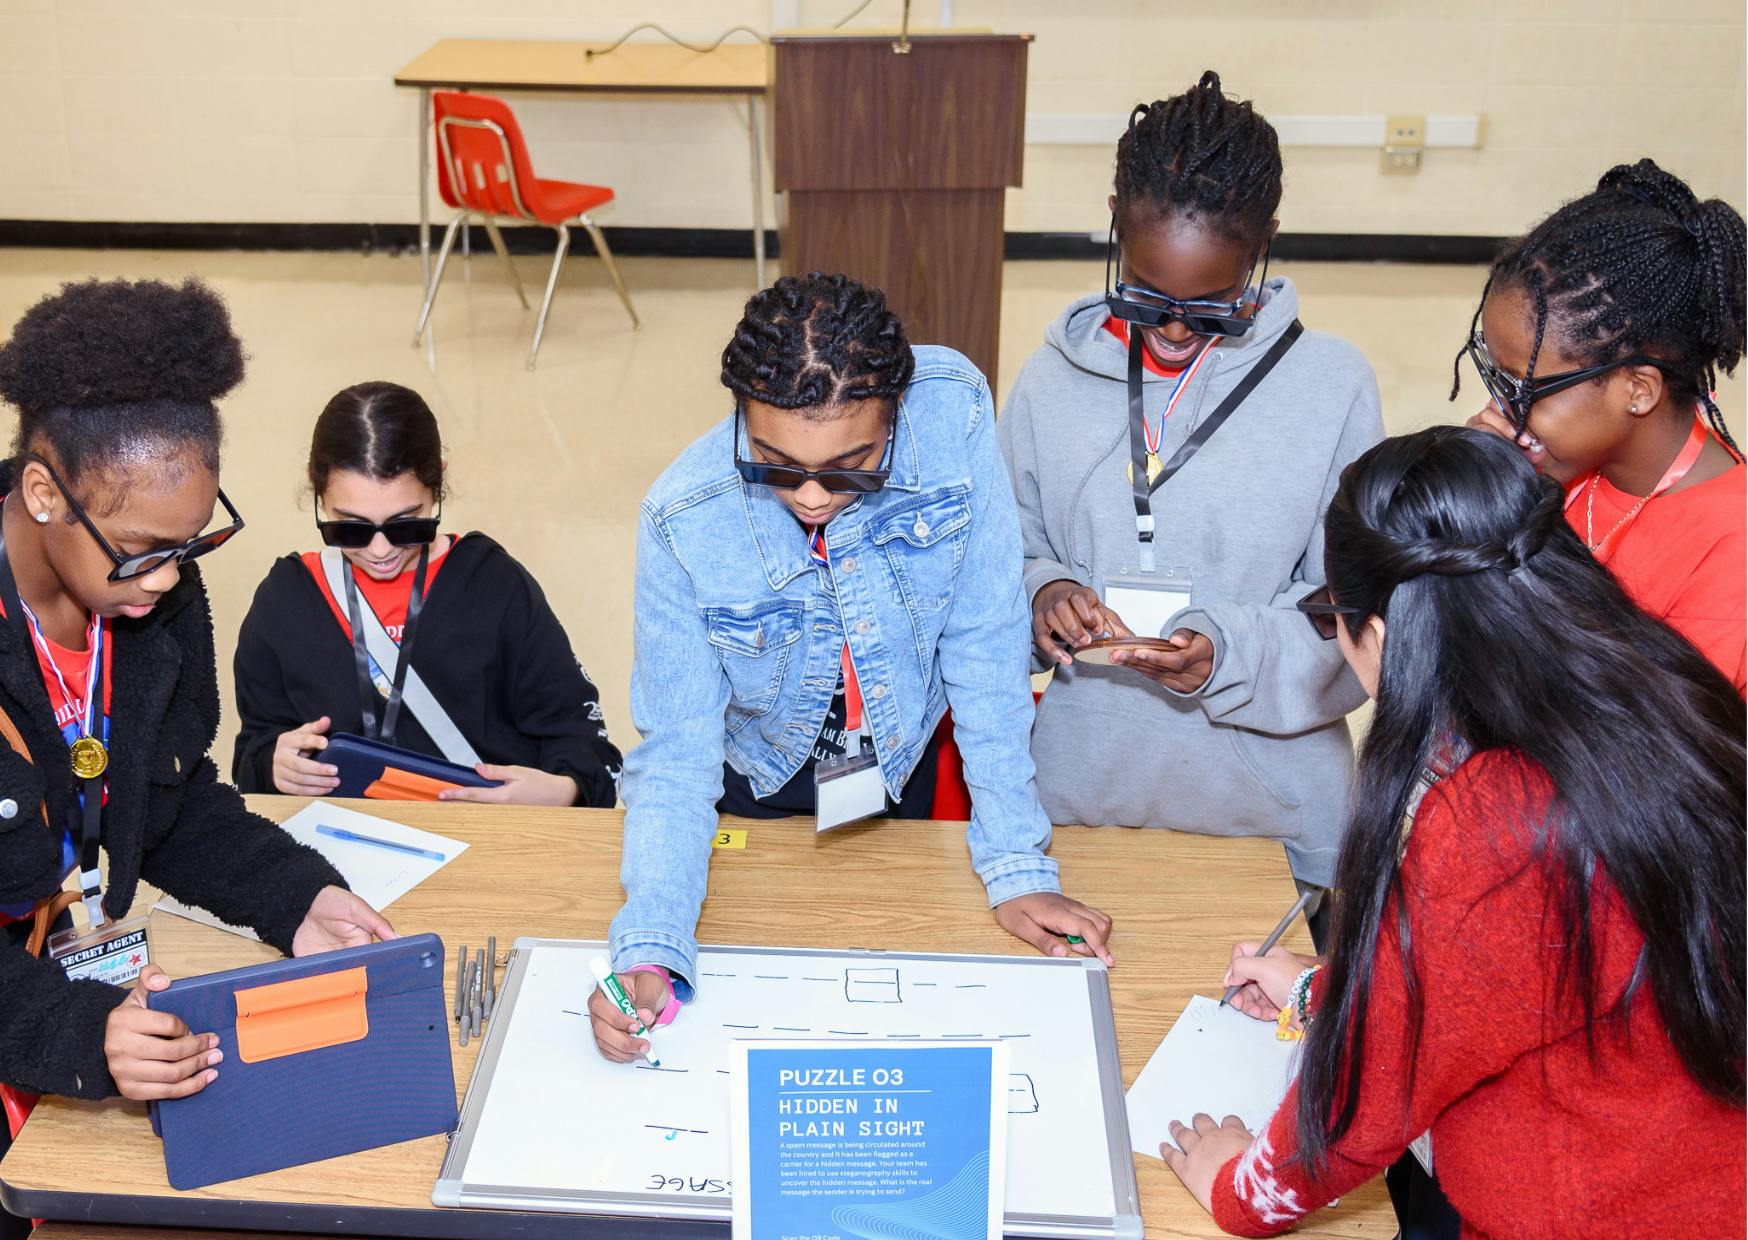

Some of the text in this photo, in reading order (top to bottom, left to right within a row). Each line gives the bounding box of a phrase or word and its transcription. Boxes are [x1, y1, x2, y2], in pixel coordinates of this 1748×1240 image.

[718, 833, 731, 845] 3
[60, 944, 104, 967] SECRET
[106, 931, 143, 952] AGENT
[779, 1069, 866, 1086] PUZZLE
[779, 1098, 898, 1114] HIDDEN IN
[779, 1121, 925, 1137] PLAIN SIGHT
[786, 1142, 805, 1150] spam
[806, 1142, 836, 1150] message
[844, 1140, 864, 1150] being
[864, 1140, 899, 1148] circulated
[900, 1140, 925, 1148] around
[793, 1151, 819, 1159] country
[856, 1188, 875, 1196] trying
